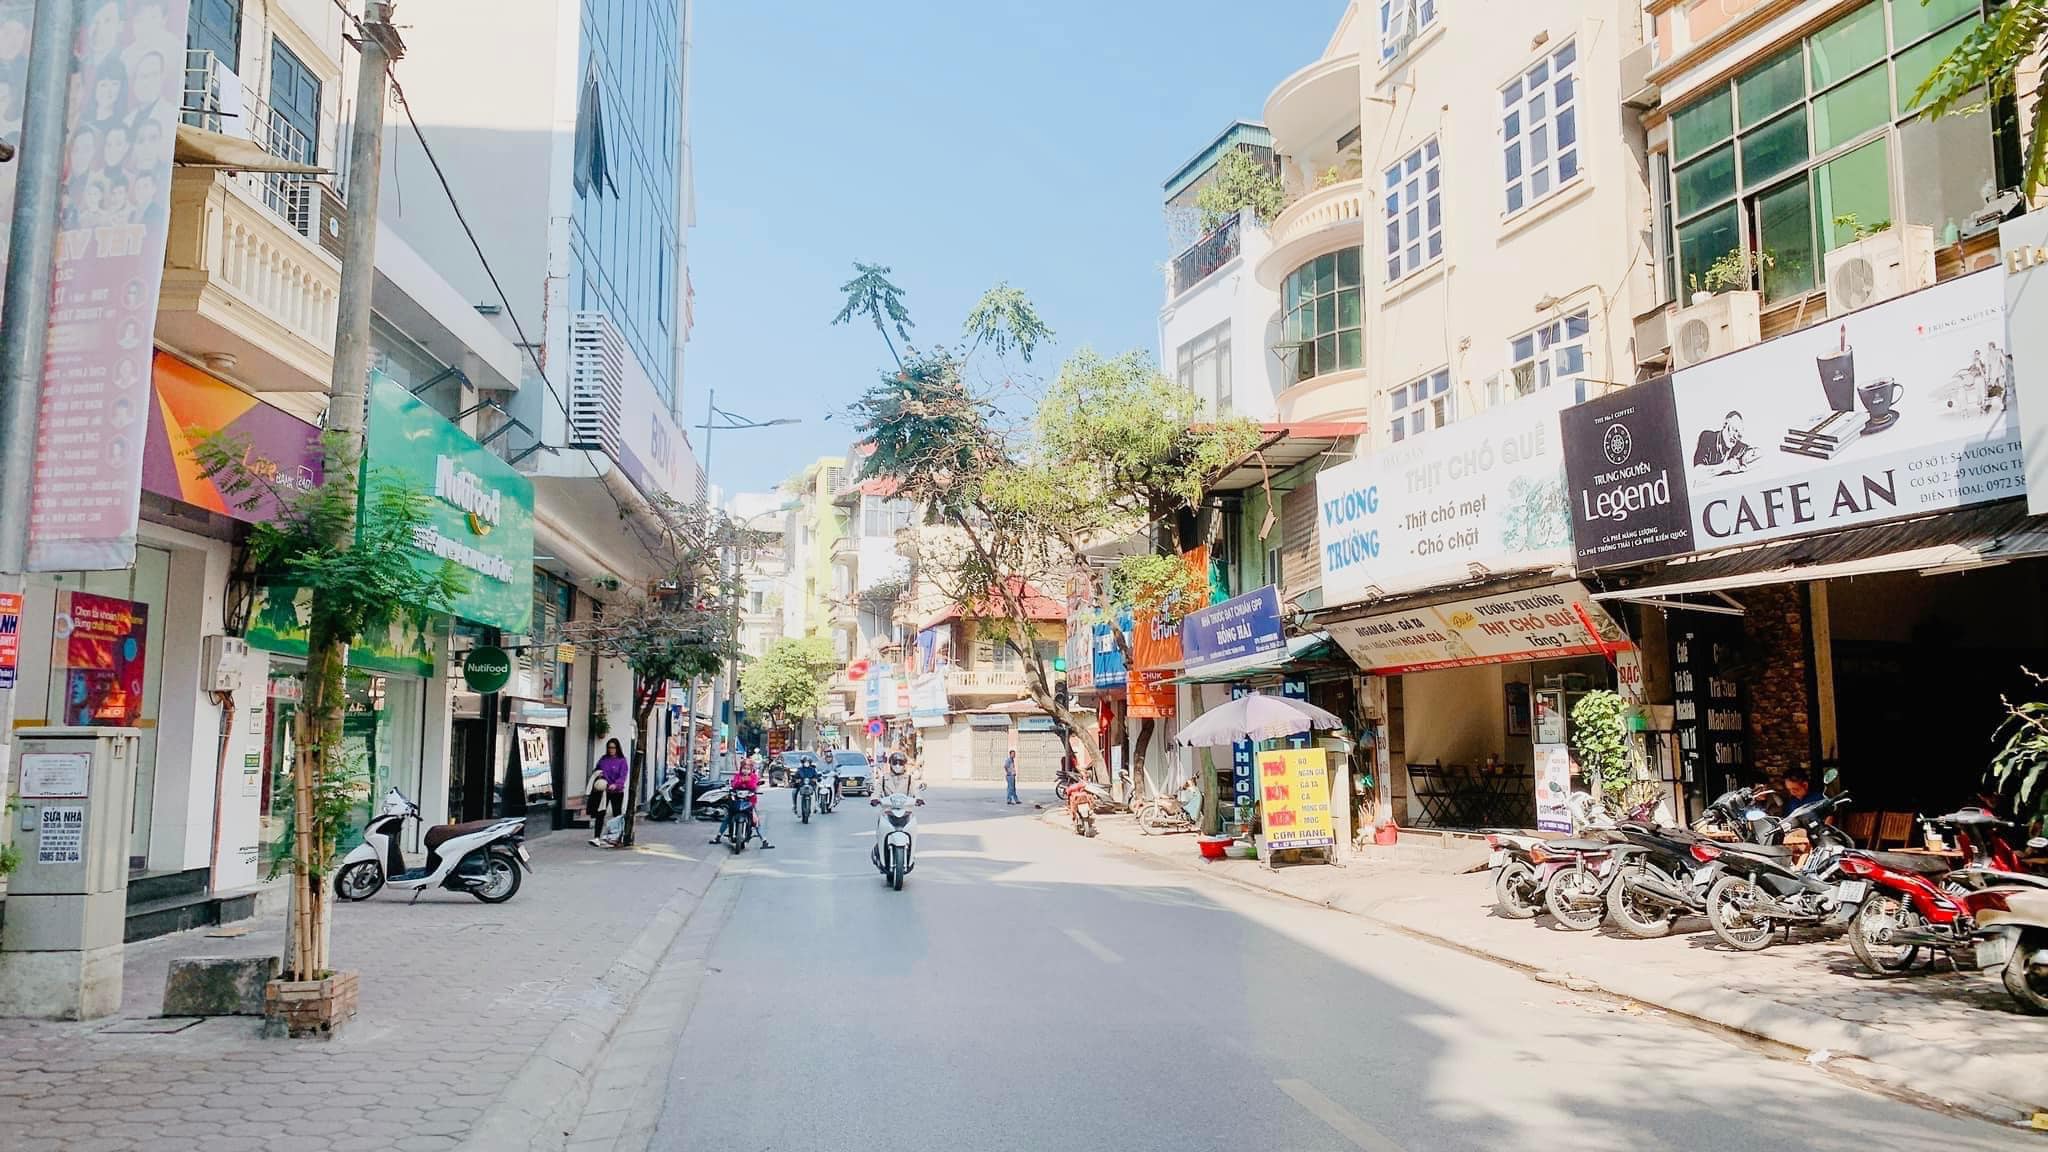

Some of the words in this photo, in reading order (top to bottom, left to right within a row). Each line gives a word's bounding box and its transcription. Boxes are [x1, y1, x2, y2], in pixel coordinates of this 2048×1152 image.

[1405, 460, 1443, 495] THỊT
[1448, 437, 1495, 480] CHÓ
[1502, 419, 1545, 465] QUÊ
[1963, 444, 2004, 460] VƯƠNG
[1593, 470, 1620, 486] TRUNG
[1620, 462, 1651, 480] NGUYÊN
[1968, 460, 2008, 476] VƯƠNG
[435, 454, 500, 527] Nutifood
[1583, 470, 1671, 521] Legend
[1986, 478, 2012, 492] 0972
[1324, 485, 1378, 528] VƯƠNG
[1405, 511, 1427, 531] Thịt
[1431, 501, 1456, 523] chó
[1460, 494, 1486, 518] mẹt
[1702, 481, 1815, 538] CAFE
[1828, 468, 1896, 518] AN
[1327, 528, 1380, 572] TRƯỜNG
[1418, 533, 1444, 556] Chó
[1448, 528, 1479, 551] chặt
[1474, 599, 1516, 616] VƯƠNG
[1514, 593, 1565, 612] TRƯỜNG
[1355, 625, 1380, 637] NGAN
[1478, 620, 1511, 638] THỊT
[1511, 613, 1545, 632] CHÓ
[1545, 608, 1580, 627] QUÊ
[1400, 634, 1427, 647] NGAN
[1525, 632, 1562, 648] Tầng
[1558, 632, 1572, 643] 2
[467, 663, 508, 673] Nutifood
[1620, 661, 1640, 684] ĐẶC
